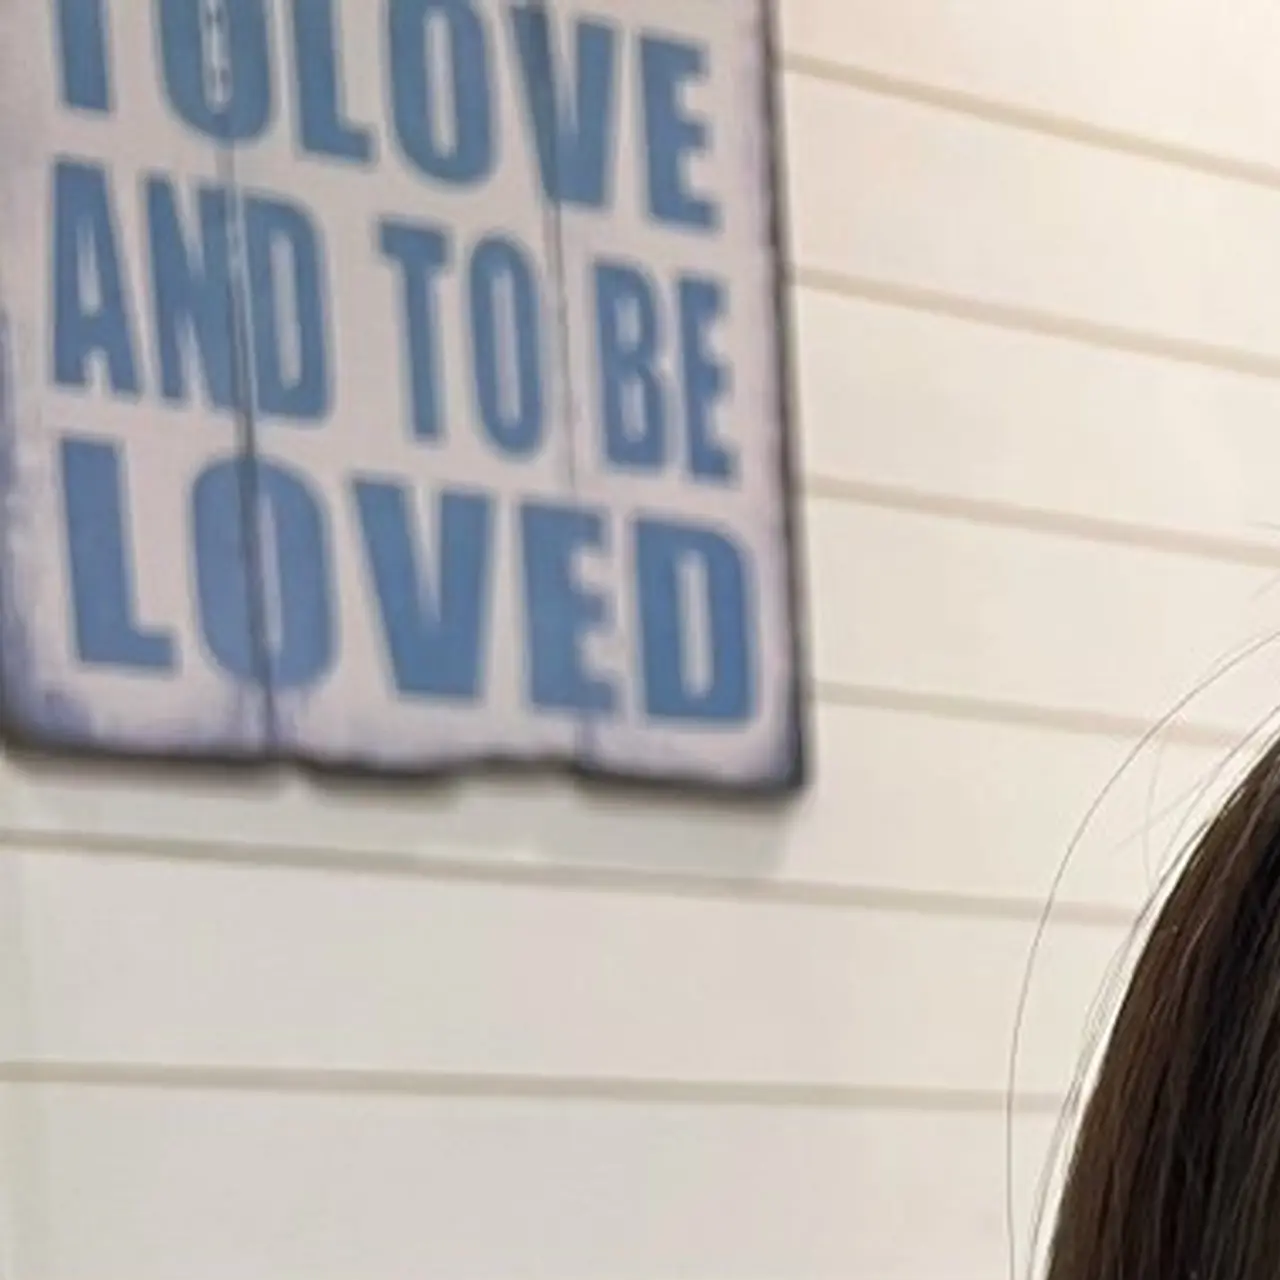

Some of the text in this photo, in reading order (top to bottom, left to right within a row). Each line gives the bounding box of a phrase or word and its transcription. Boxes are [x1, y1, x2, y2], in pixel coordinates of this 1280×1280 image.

[52, 160, 737, 482] AND TO BE
[59, 437, 755, 724] LOVED
